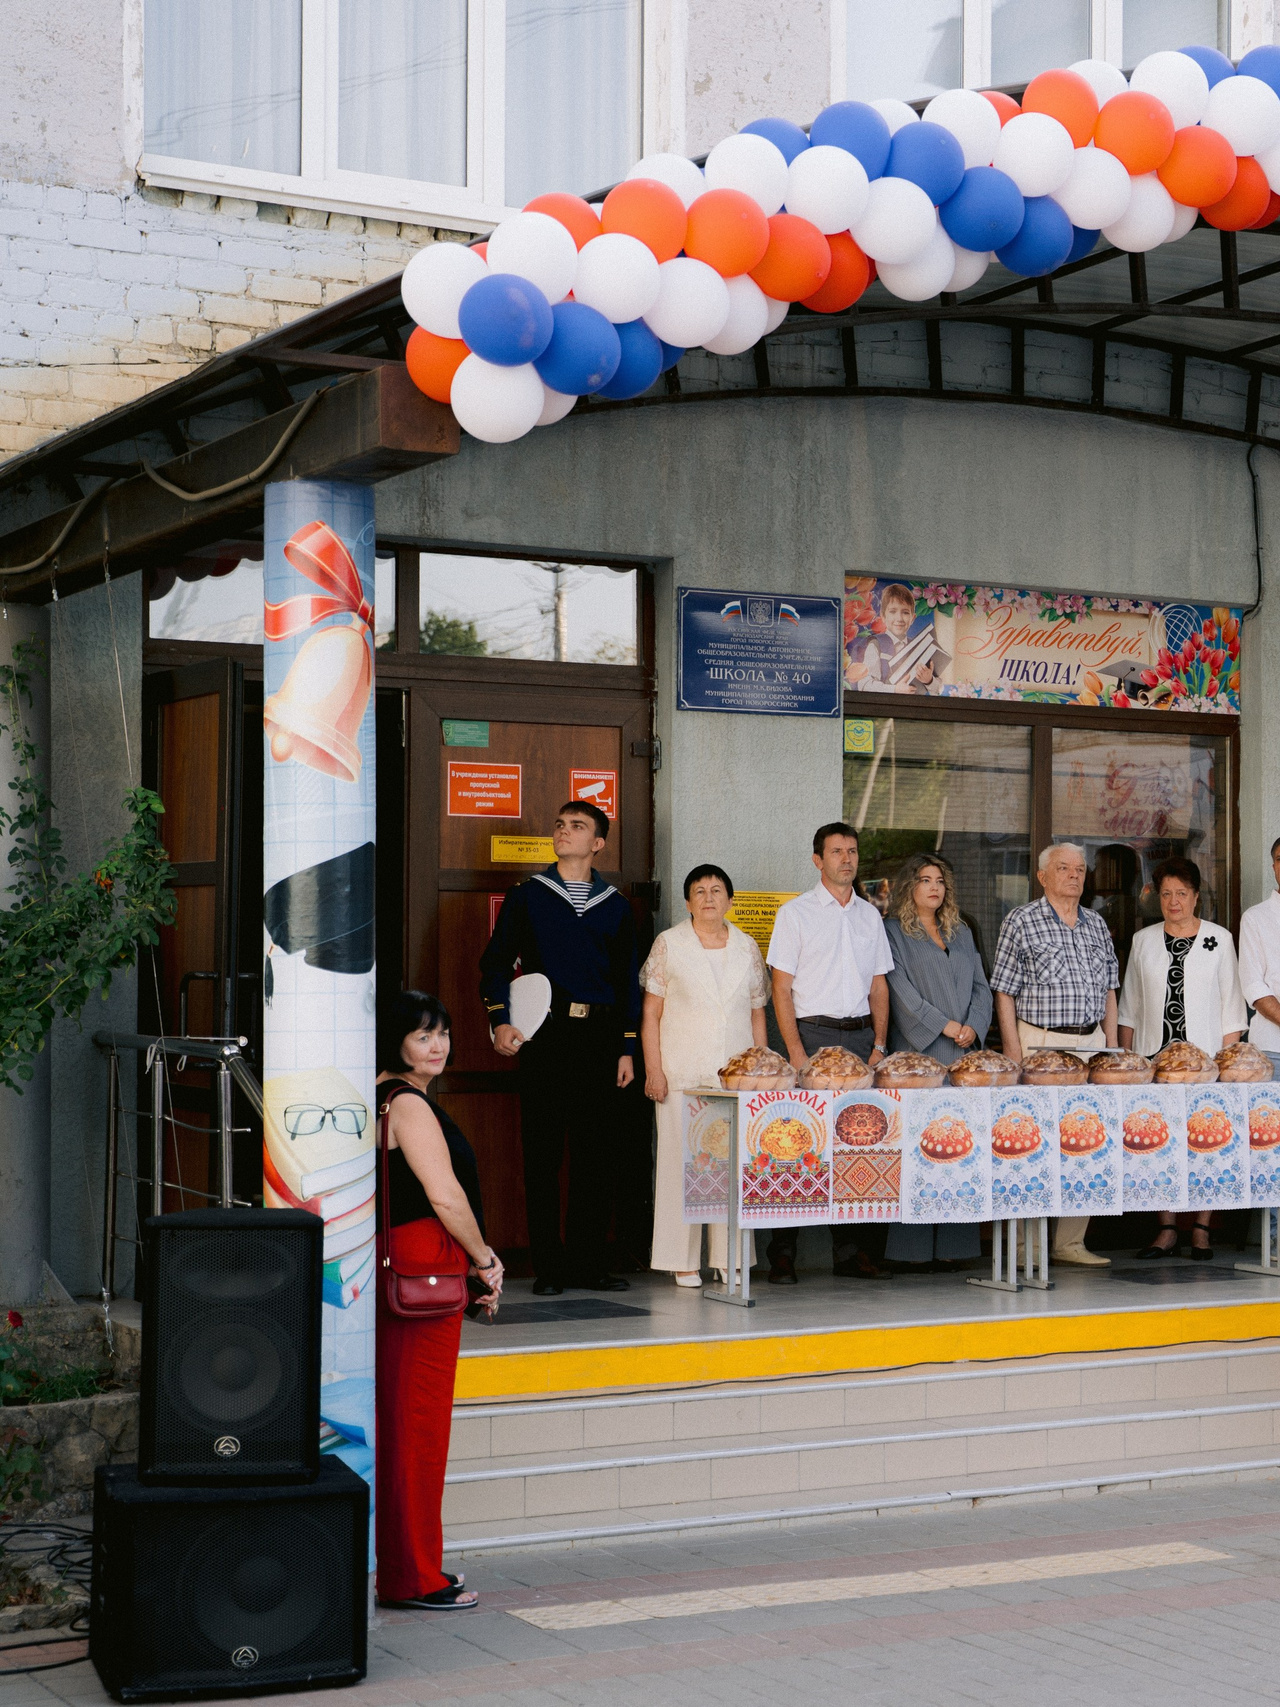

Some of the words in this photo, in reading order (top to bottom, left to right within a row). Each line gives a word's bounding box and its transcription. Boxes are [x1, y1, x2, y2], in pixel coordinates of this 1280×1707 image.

[955, 605, 1146, 668] Здравствуй,
[708, 643, 766, 651] МУНИЦИПАЛЬНОЕ
[768, 646, 812, 654] АВТОНОМНОЕ
[697, 649, 778, 660] ОБЩЕОБРАЗОВАТЕЛЬНОЕ
[736, 661, 816, 671] ОБЩЕОБРАЗОВАТЕЛЬНАЯ
[710, 668, 766, 682] ШКОЛА
[774, 672, 788, 683] №
[792, 672, 811, 684] 40
[999, 658, 1081, 686] ШКОЛА!
[705, 690, 766, 699] МУНИЦИПАЛЬНОГО
[769, 693, 815, 702] ОБРАЗОВАНИЯ
[746, 700, 799, 708] НОВОРОССИЙСК
